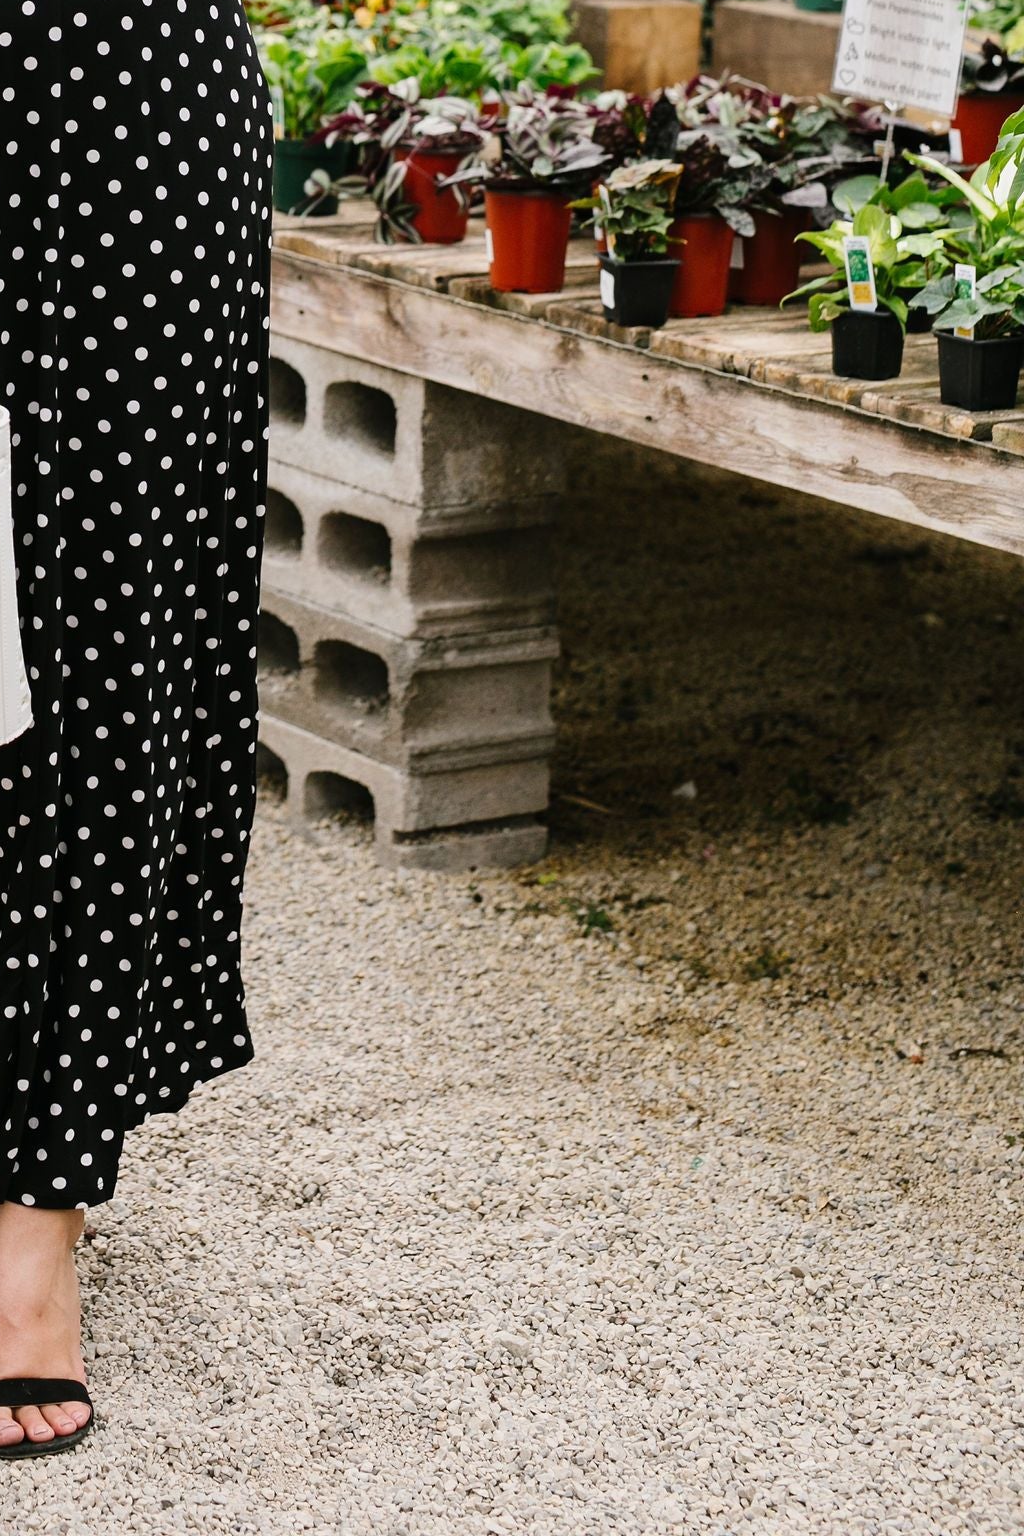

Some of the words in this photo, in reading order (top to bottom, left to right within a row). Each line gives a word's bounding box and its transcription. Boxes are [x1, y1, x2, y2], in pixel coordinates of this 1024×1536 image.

[870, 25, 895, 40] Bright
[898, 31, 930, 44] indirect
[932, 37, 951, 51] light
[864, 50, 897, 64] Medium
[900, 60, 924, 72] water
